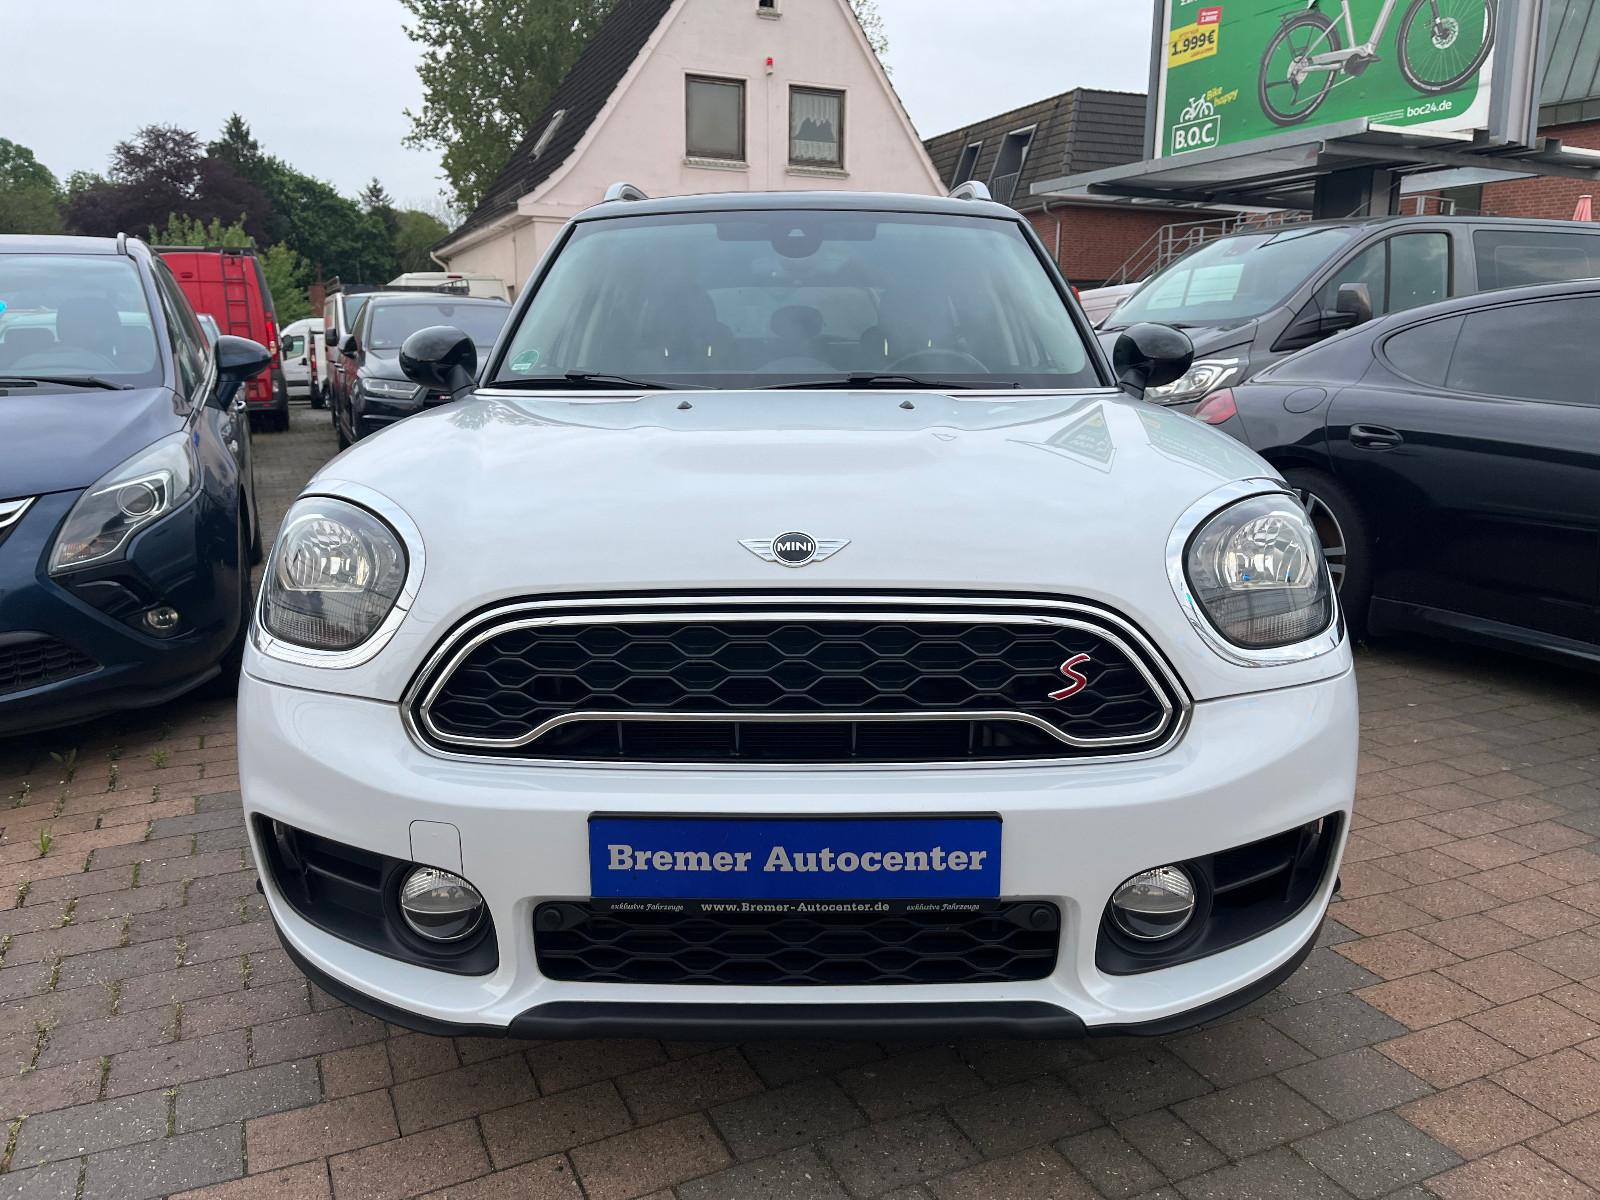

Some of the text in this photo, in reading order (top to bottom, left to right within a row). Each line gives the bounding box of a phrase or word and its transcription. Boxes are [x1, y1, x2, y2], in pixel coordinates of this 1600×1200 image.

[1171, 29, 1215, 56] 1.999€
[1406, 100, 1452, 117] boc24.de
[1175, 123, 1215, 149] B.O.C.
[777, 541, 812, 551] MINI
[1048, 653, 1091, 700] S
[607, 844, 987, 872] Bremer Autocenter
[610, 902, 684, 912] exklusive Fahrzeuge
[701, 902, 890, 912] www.Bremer-Autocenter.de
[906, 902, 980, 912] exklusive Fahrzeuge
